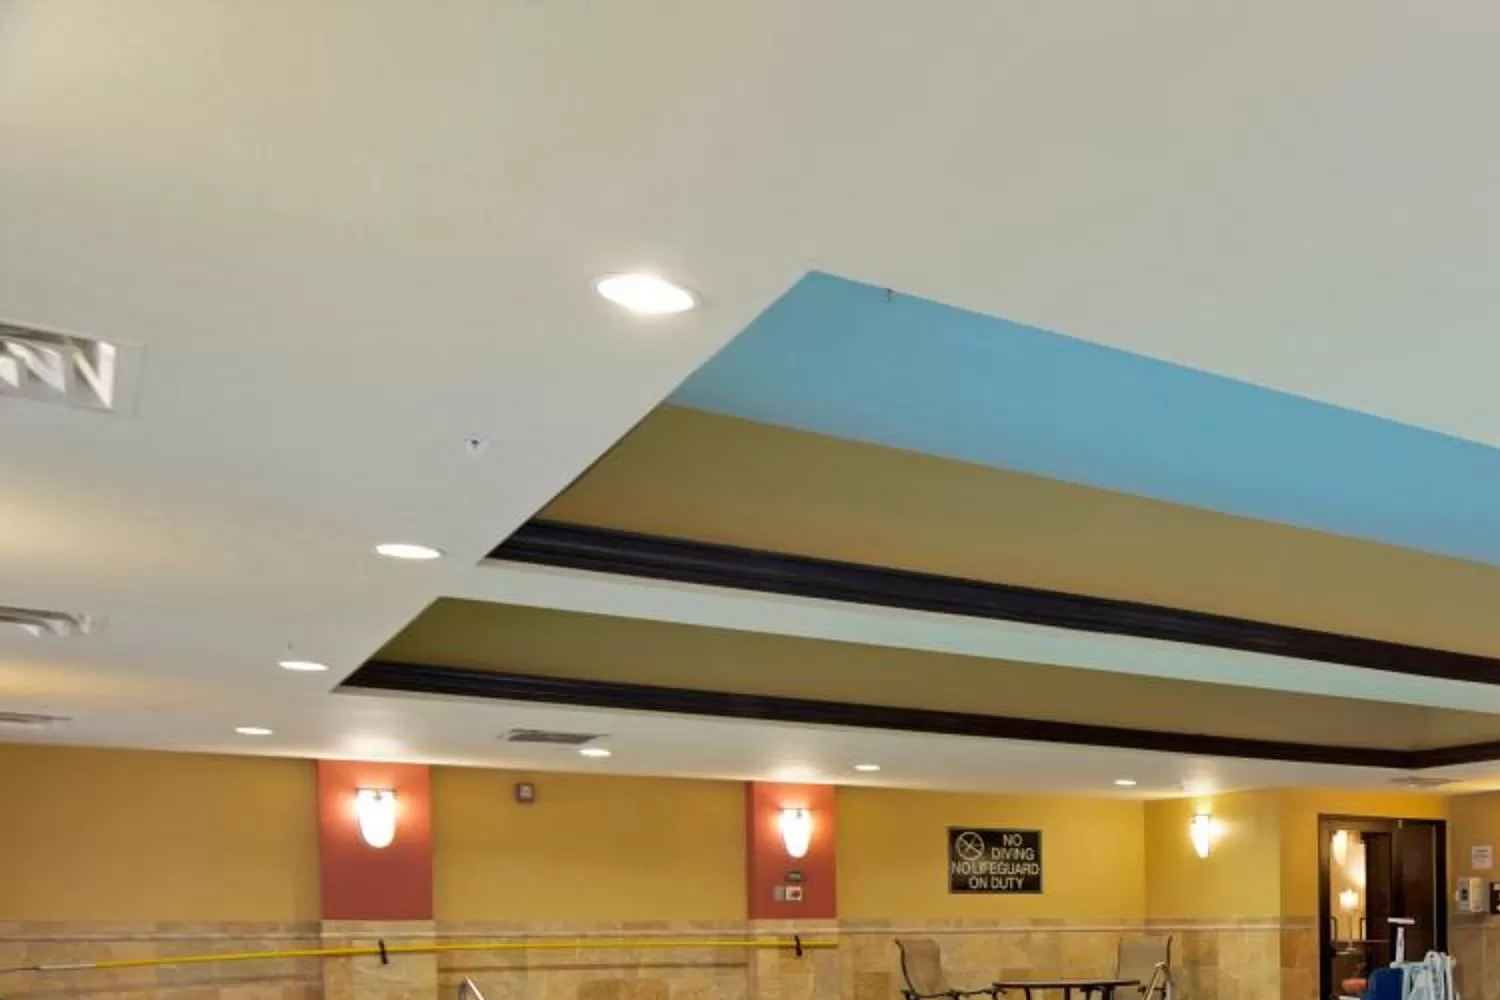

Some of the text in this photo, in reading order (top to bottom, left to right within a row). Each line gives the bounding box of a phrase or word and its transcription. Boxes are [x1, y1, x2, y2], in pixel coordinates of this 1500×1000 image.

[1003, 834, 1023, 847] NO
[991, 847, 1035, 861] DIVING
[951, 861, 1040, 876] NO LIFEGUARD
[968, 876, 1025, 889] ON DUTY
